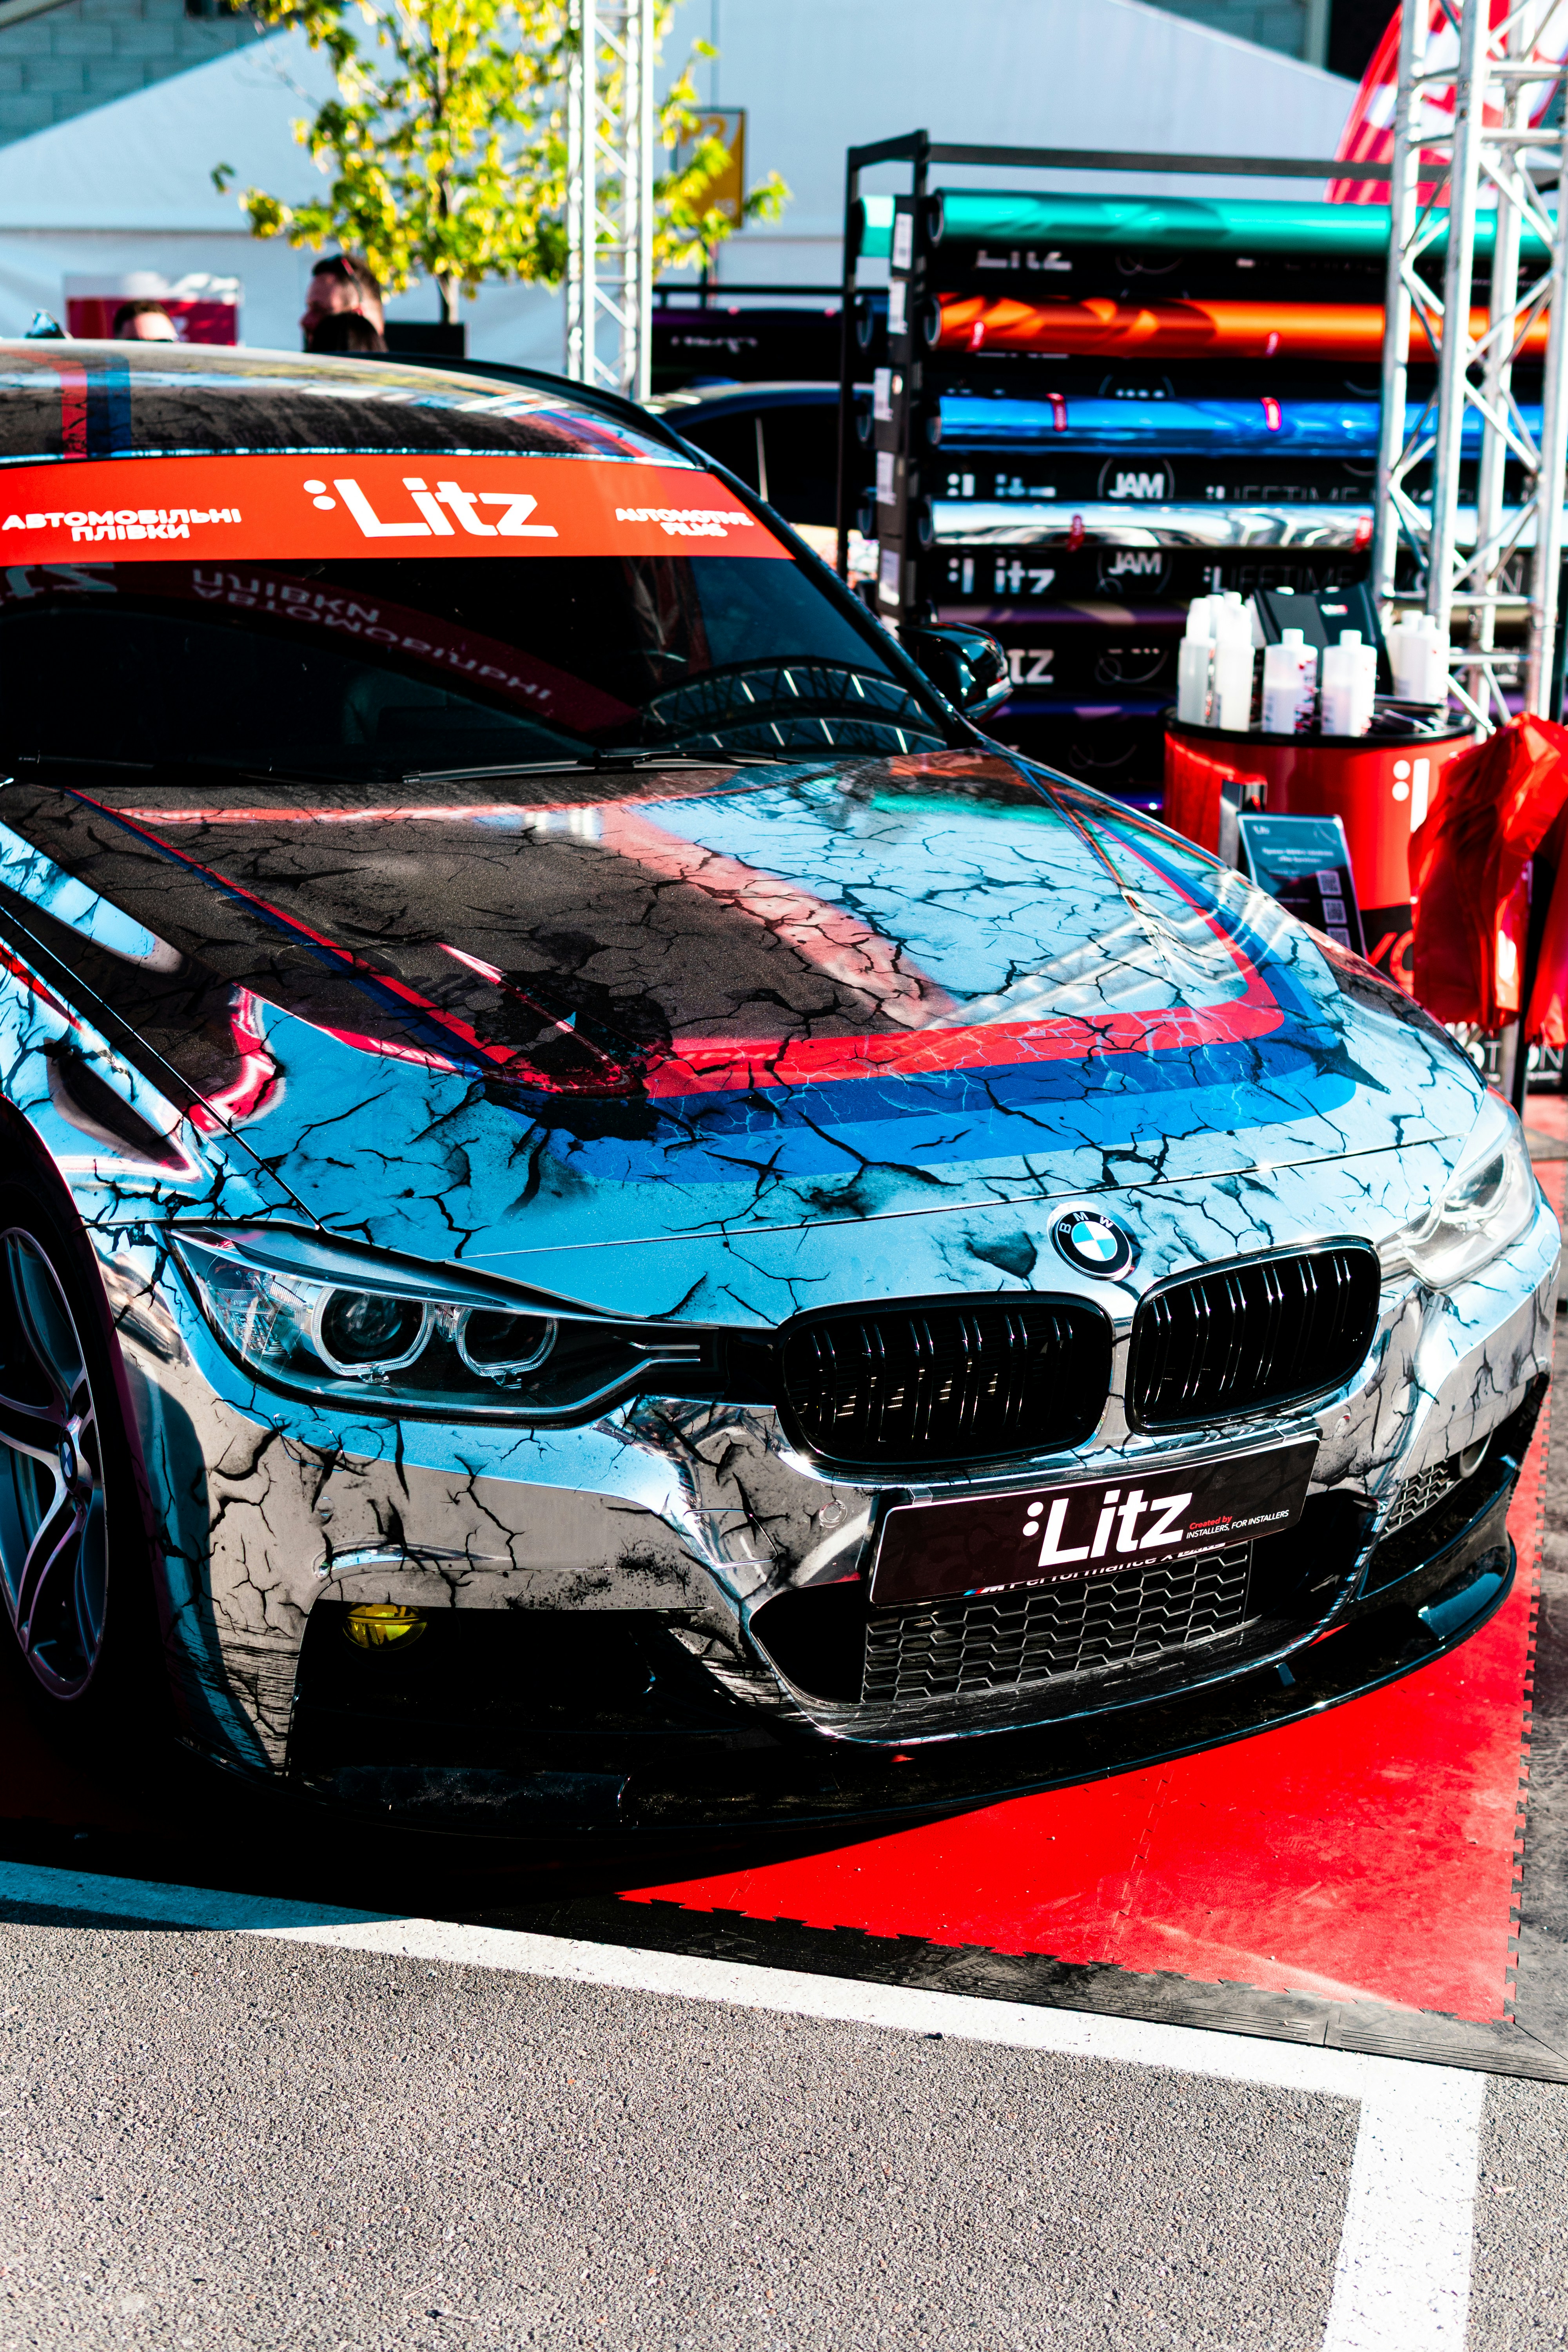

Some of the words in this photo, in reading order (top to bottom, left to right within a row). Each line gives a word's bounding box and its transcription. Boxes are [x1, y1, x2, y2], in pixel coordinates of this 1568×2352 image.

[1108, 473, 1164, 499] JAM
[2, 509, 242, 530] АВТОМОБІЛЬНІ
[615, 508, 755, 526] AUTOMOTIVE
[71, 524, 190, 542] ПЛІВКИ
[1108, 552, 1161, 575] JAM
[1059, 1212, 1114, 1234] BMW
[1186, 1523, 1230, 1539] INSTALLERS,
[1231, 1519, 1247, 1529] FOR
[1248, 1509, 1289, 1525] INSTALLERS
[1189, 1516, 1221, 1530] Created
